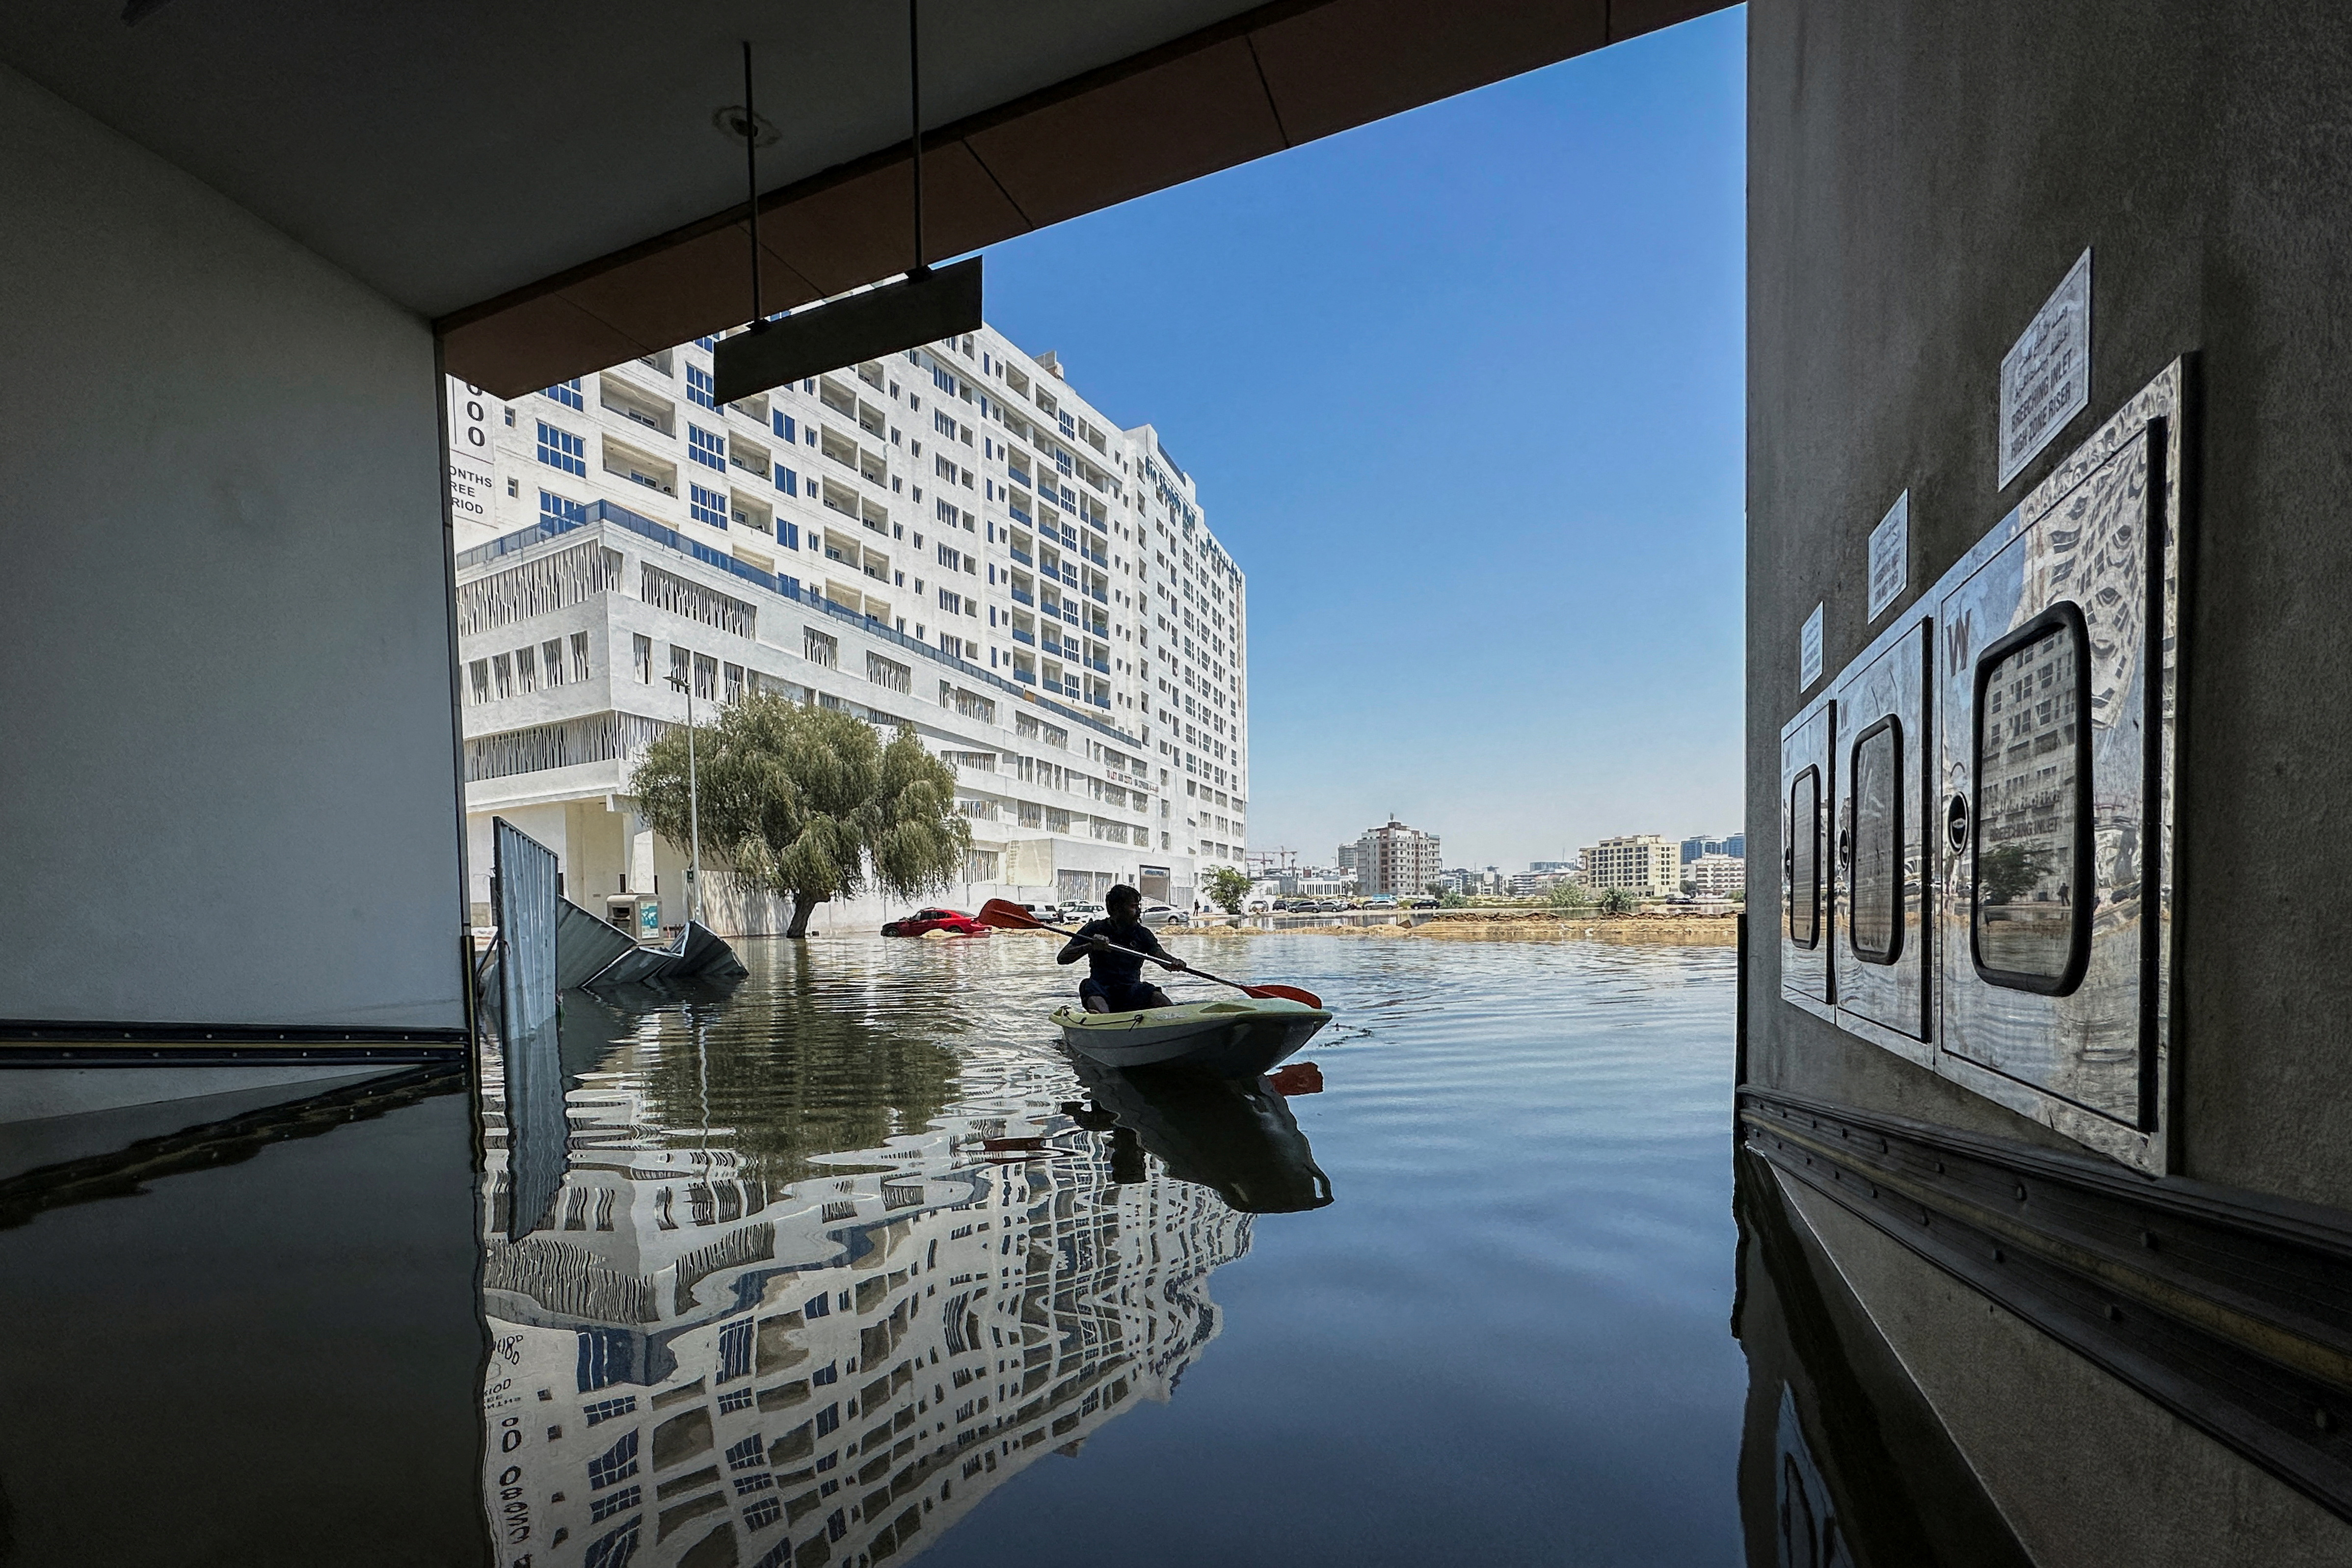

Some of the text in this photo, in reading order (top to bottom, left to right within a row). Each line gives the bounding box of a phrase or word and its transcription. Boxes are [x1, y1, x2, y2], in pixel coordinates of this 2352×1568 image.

[2011, 373, 2049, 433] BREECHING
[2051, 347, 2072, 389] INLET
[2011, 379, 2070, 460] HIGH ZONE RISER
[1145, 455, 1157, 485] Bin
